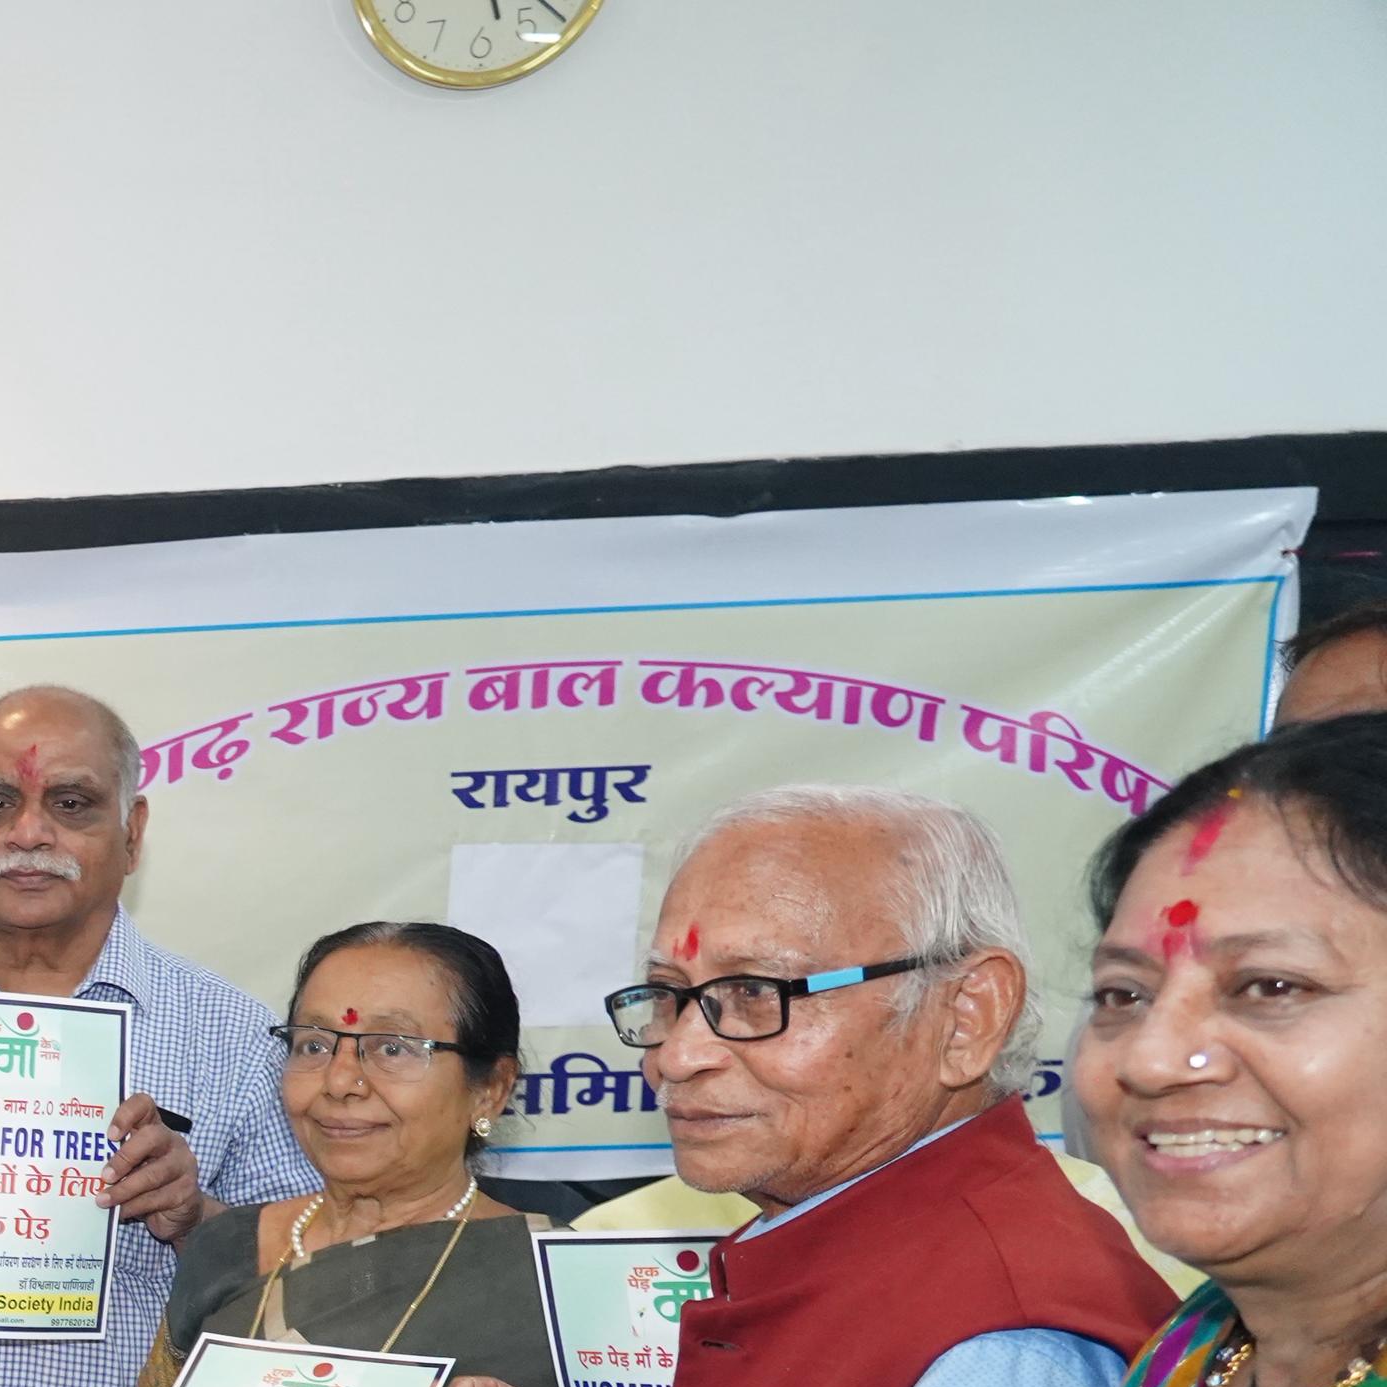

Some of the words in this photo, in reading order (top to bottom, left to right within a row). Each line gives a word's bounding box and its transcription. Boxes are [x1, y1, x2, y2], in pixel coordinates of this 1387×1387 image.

[427, 19, 446, 52] 7
[516, 7, 537, 41] 5
[470, 26, 492, 59] 6
[269, 671, 450, 746] राज्य
[465, 658, 623, 709] बाल
[638, 659, 946, 744] कल्याण
[450, 763, 652, 823] रायपुर
[0, 1126, 44, 1158] FOR
[24, 1164, 53, 1196] के
[627, 1275, 651, 1292] पेड़
[633, 1266, 660, 1278] एक
[577, 1350, 603, 1369] एक
[608, 1345, 630, 1371] पेड़
[634, 1345, 651, 1368] माँ
[656, 1346, 673, 1368] के
